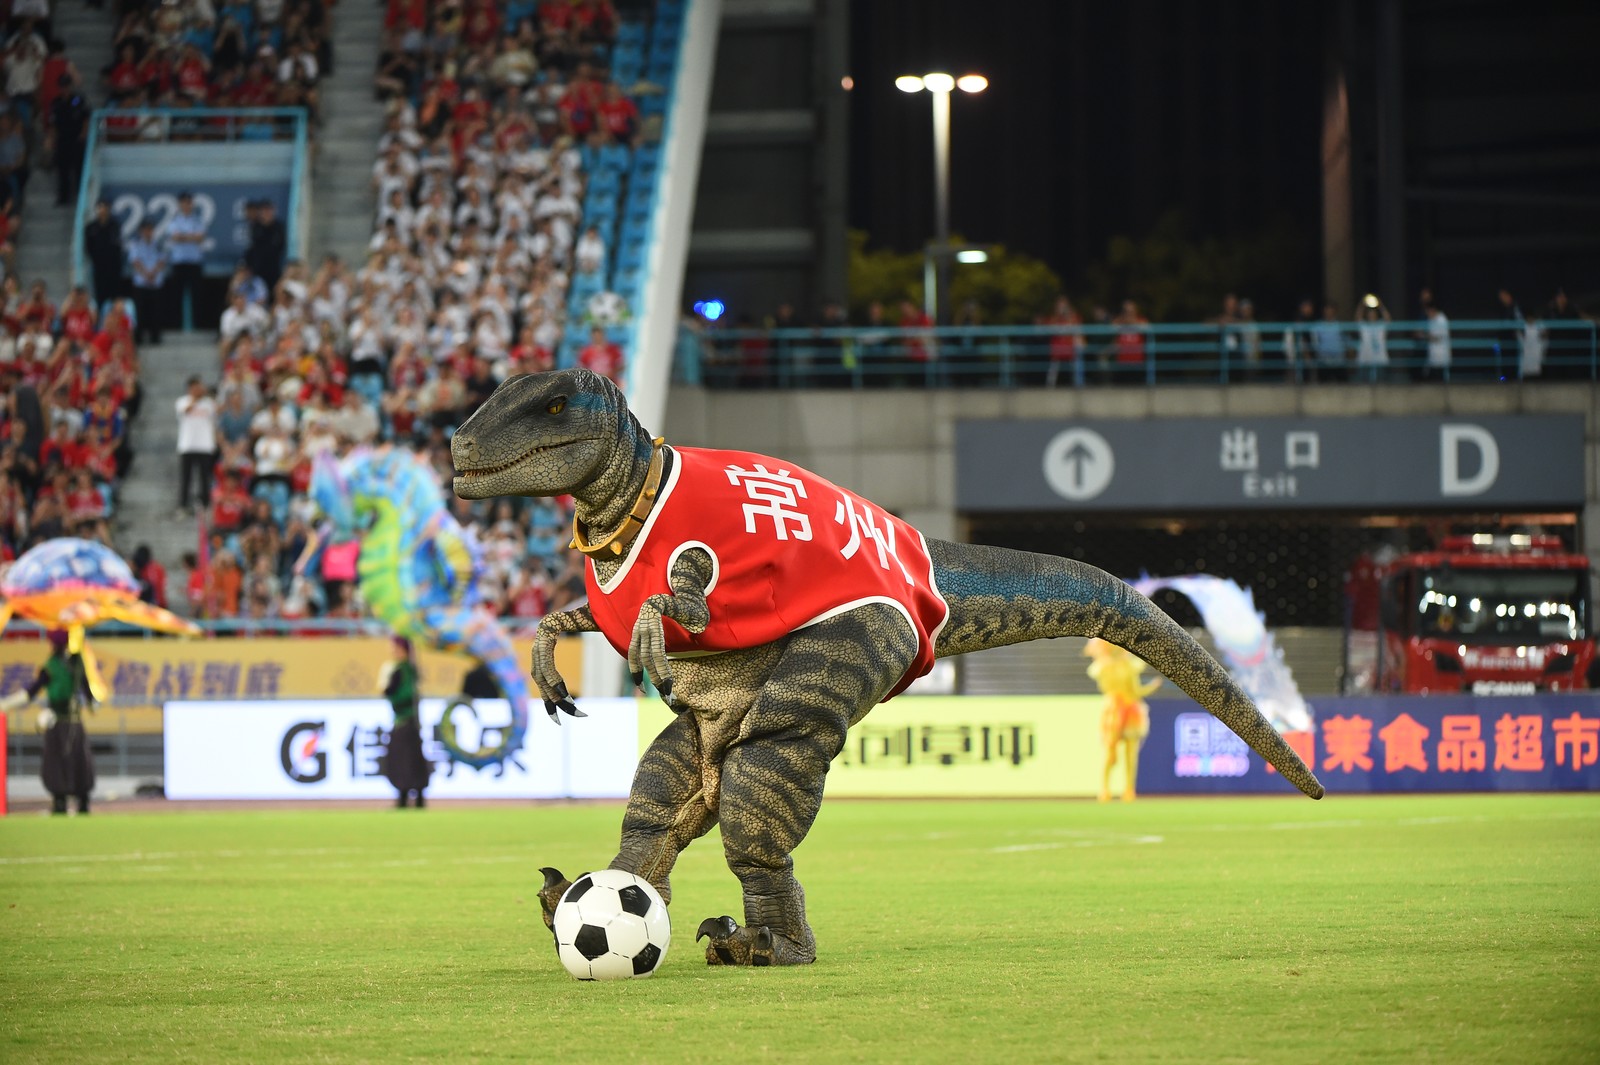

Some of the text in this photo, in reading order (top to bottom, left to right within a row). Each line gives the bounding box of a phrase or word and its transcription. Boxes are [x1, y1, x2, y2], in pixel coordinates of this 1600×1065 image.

[1220, 427, 1320, 470] 出口
[1440, 423, 1500, 497] D
[1242, 472, 1297, 498] Exit
[723, 463, 915, 587] 常州
[845, 723, 1035, 767] 创草坪
